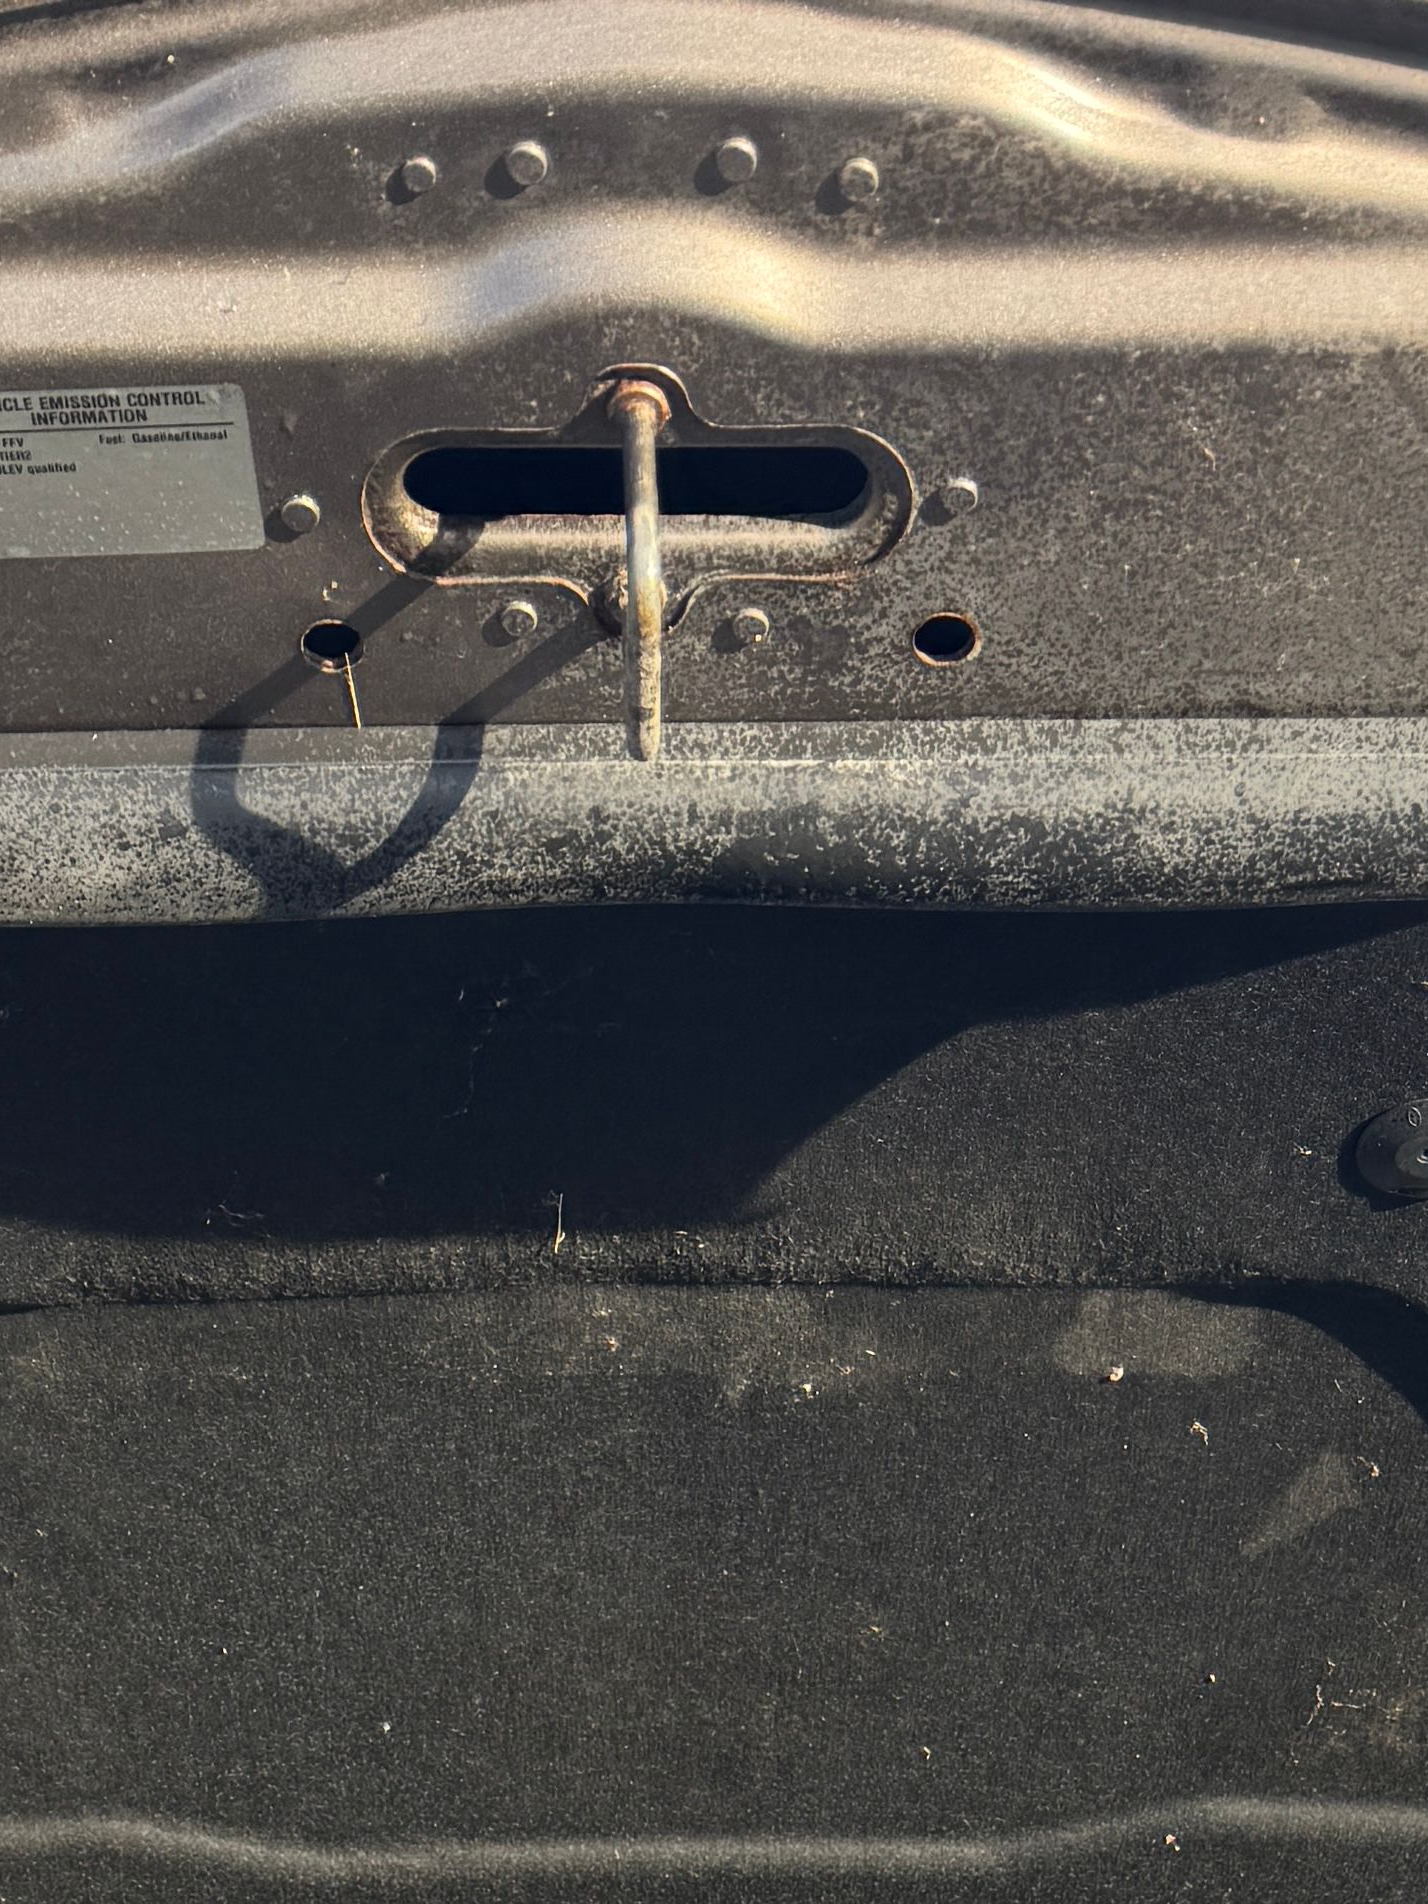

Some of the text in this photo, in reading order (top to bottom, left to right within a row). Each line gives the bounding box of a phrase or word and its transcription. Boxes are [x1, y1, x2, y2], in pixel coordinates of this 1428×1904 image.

[39, 393, 122, 412] EMISSION
[127, 391, 206, 409] CONTROL
[31, 408, 148, 427] INFORMATION
